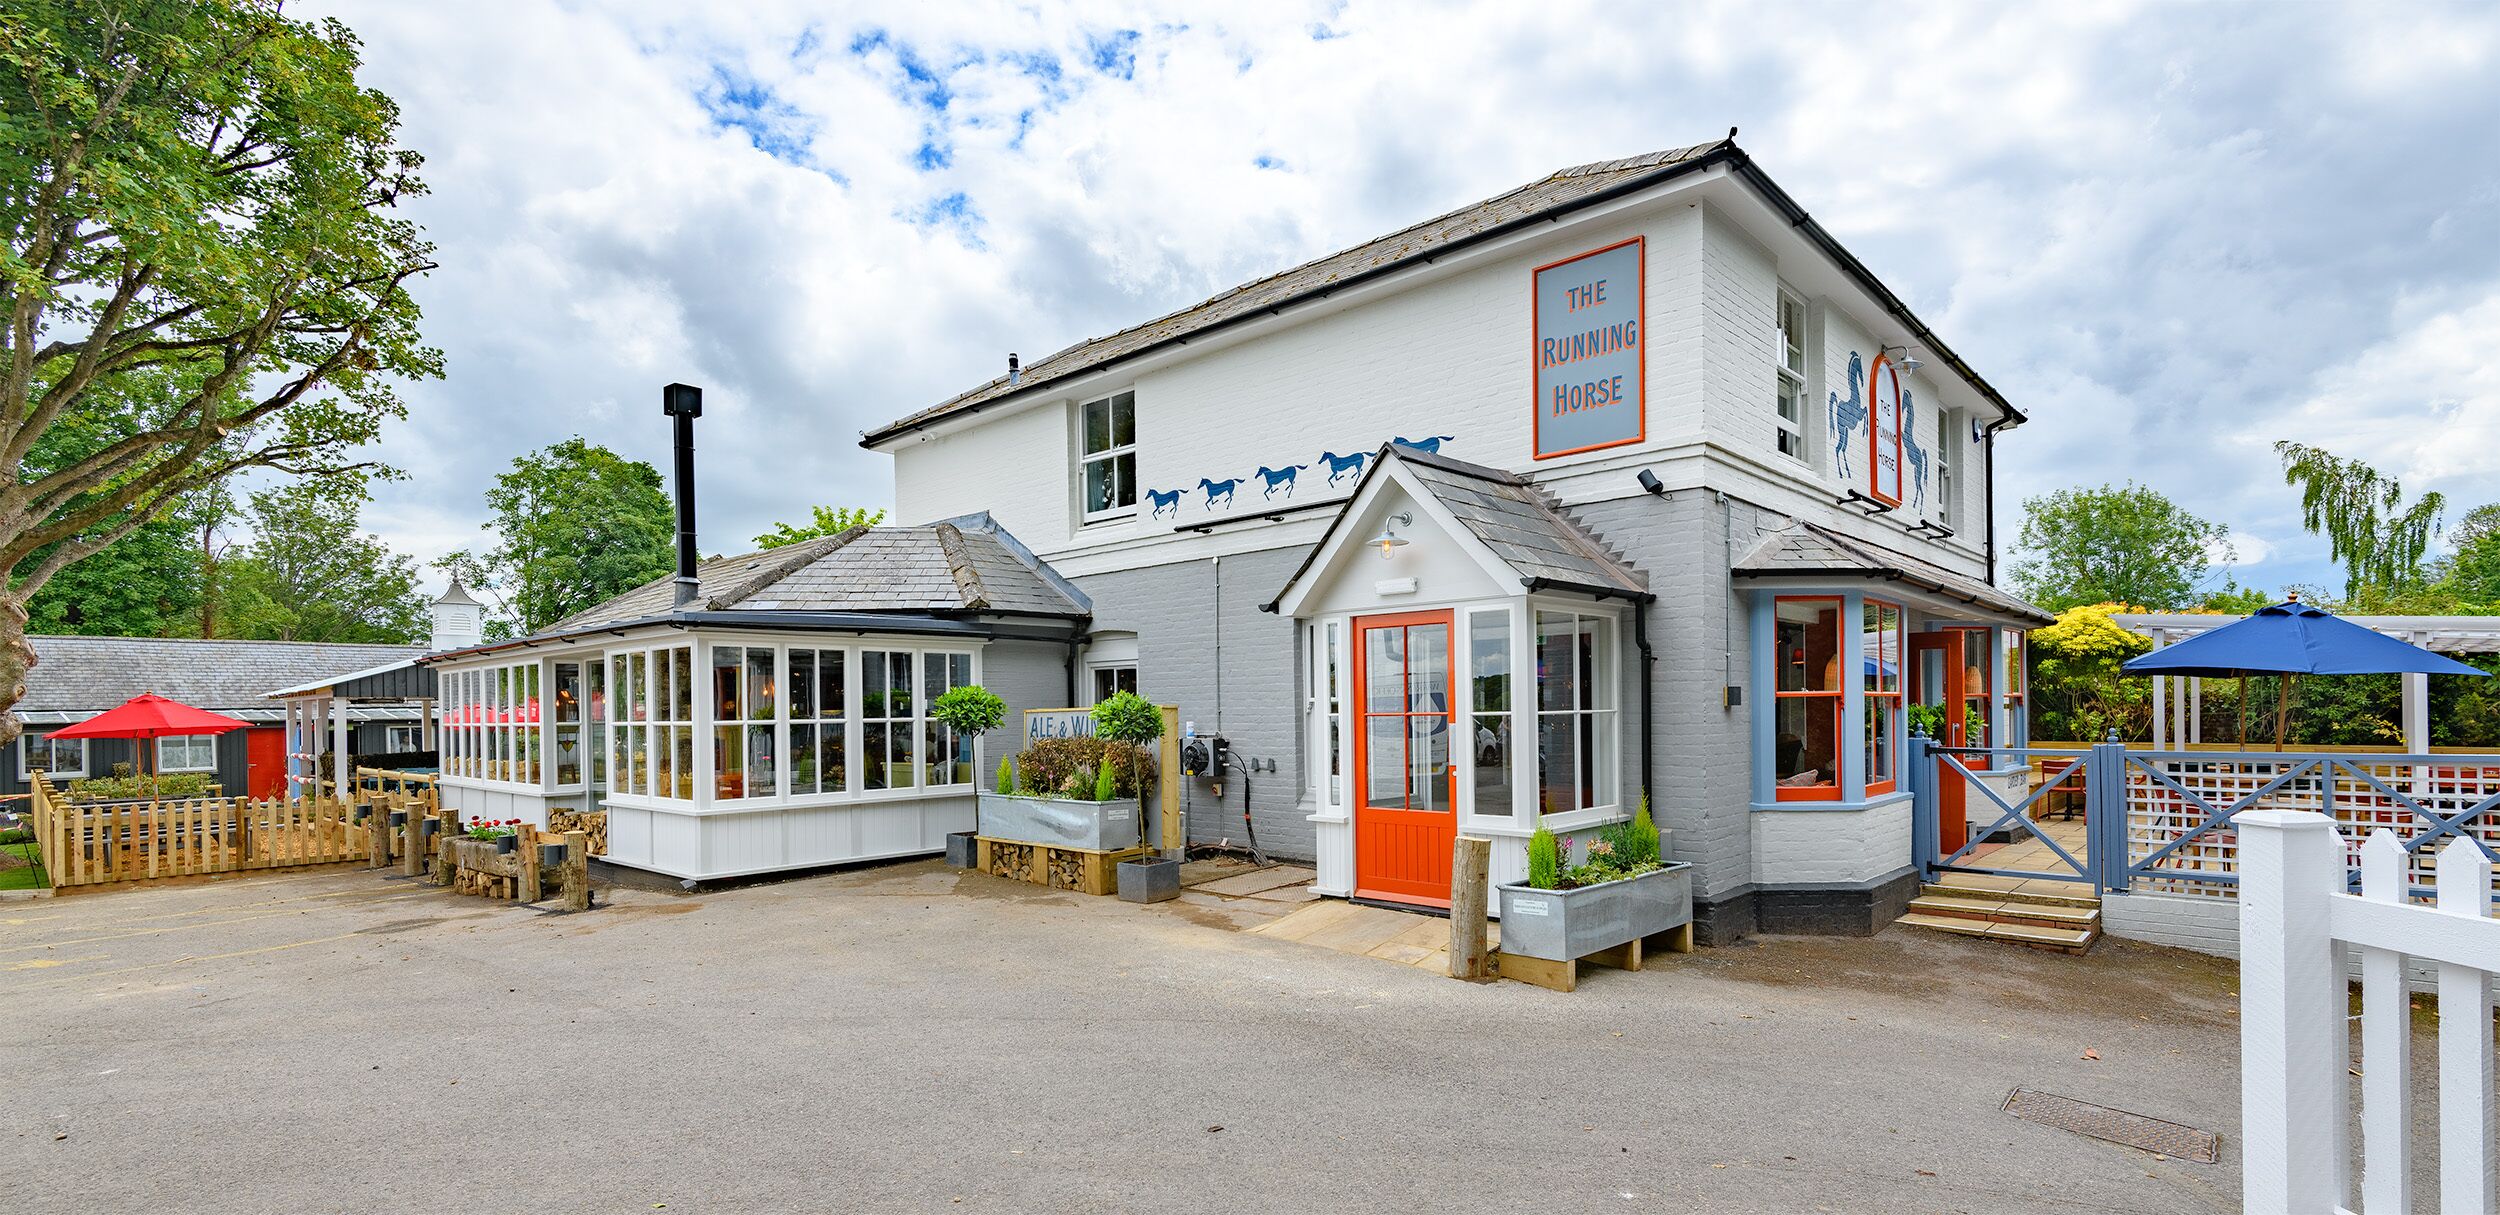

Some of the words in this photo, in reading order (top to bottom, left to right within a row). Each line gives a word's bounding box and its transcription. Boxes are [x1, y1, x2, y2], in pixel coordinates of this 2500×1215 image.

[1566, 279, 1607, 313] THE
[1541, 320, 1636, 369] RUNNING
[1553, 375, 1622, 417] HORSE
[1880, 399, 1891, 417] THE
[1878, 447, 1895, 472] HORSE
[1030, 716, 1053, 738] ALE
[1059, 720, 1067, 738] &
[1071, 715, 1100, 738] WIN
